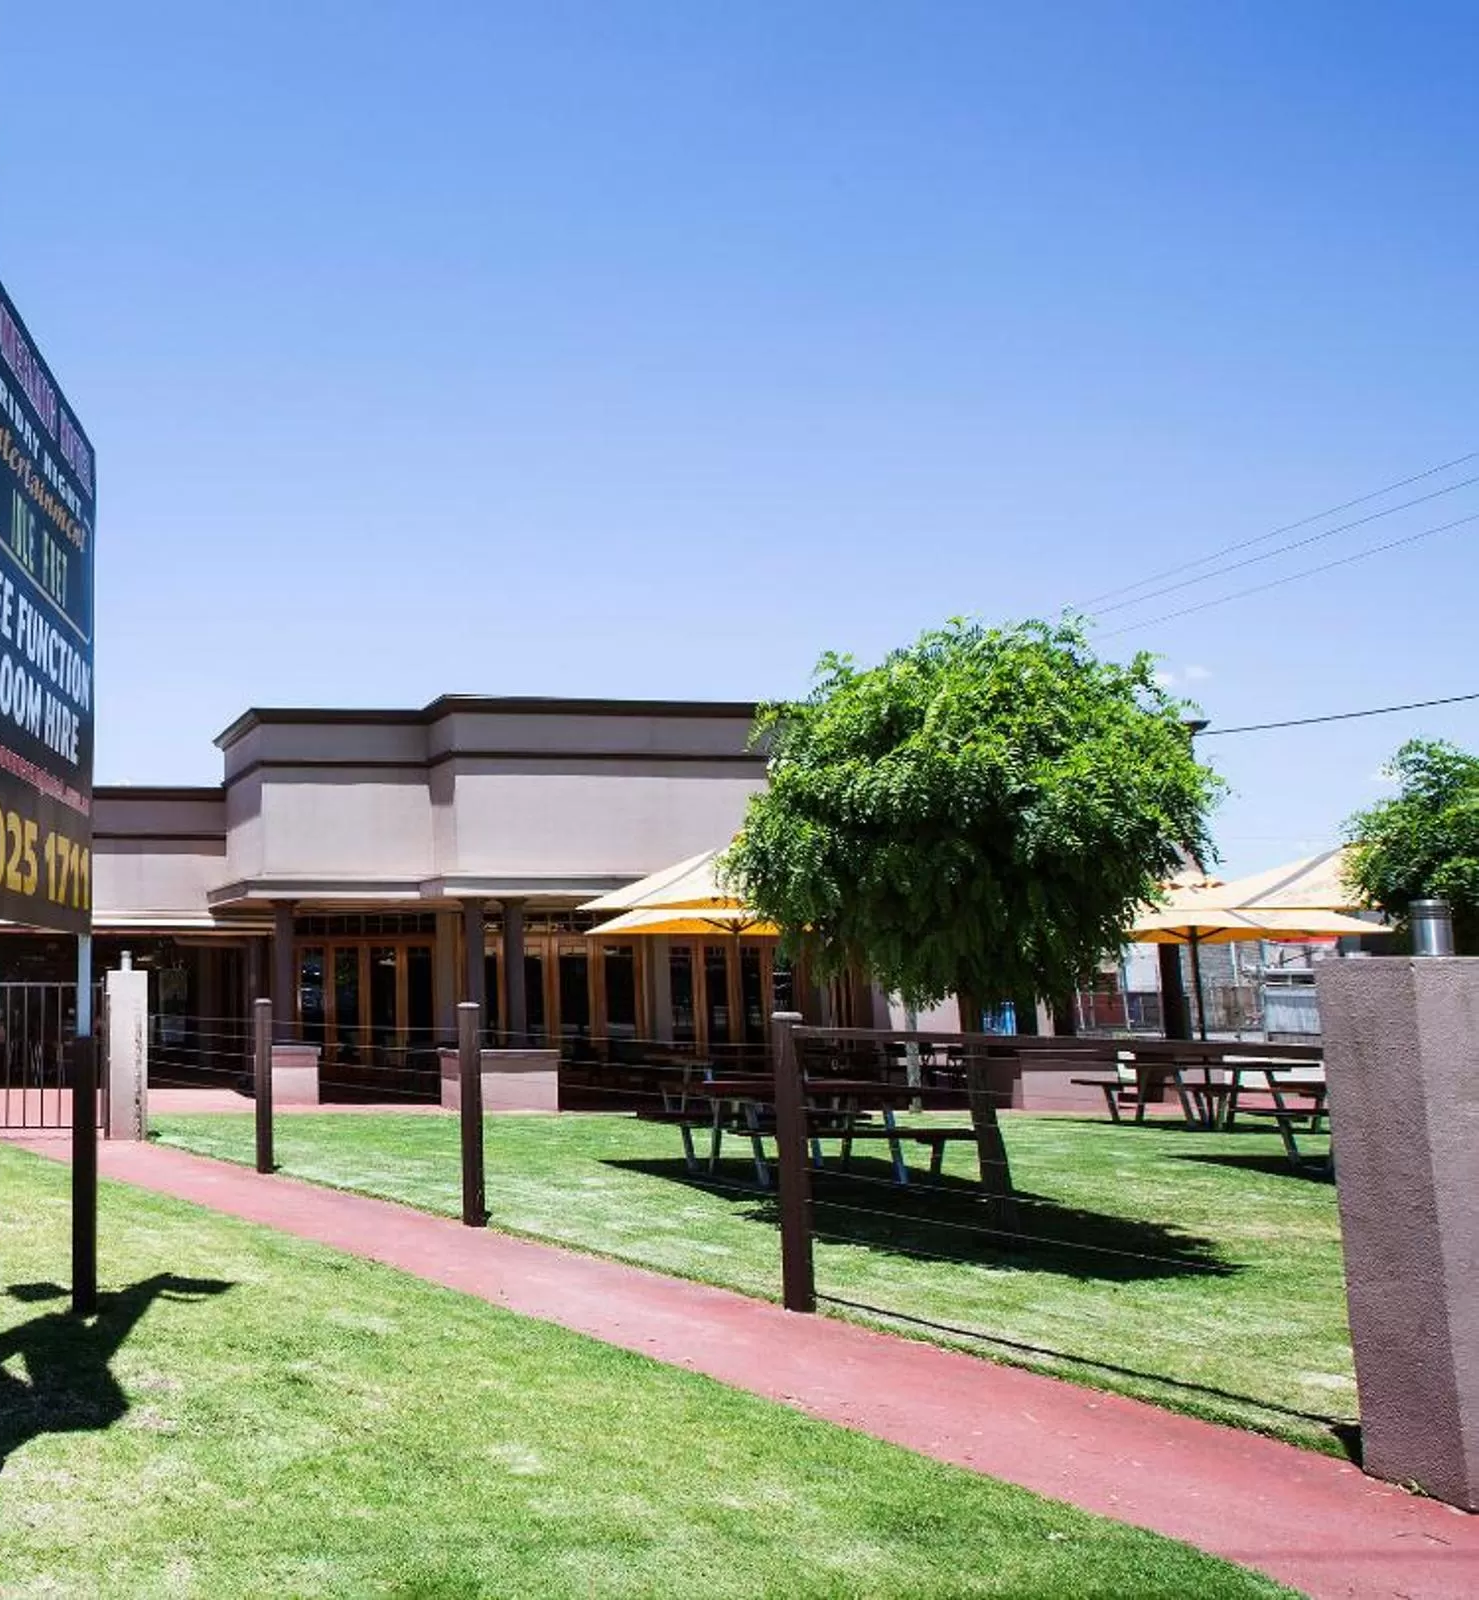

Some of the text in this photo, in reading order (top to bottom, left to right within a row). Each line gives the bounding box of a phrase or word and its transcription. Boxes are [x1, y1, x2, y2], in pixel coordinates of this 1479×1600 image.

[43, 451, 81, 521] NIGHT
[17, 593, 91, 712] FUNCTION
[44, 691, 80, 766] HIRE
[44, 832, 90, 911] 1711
